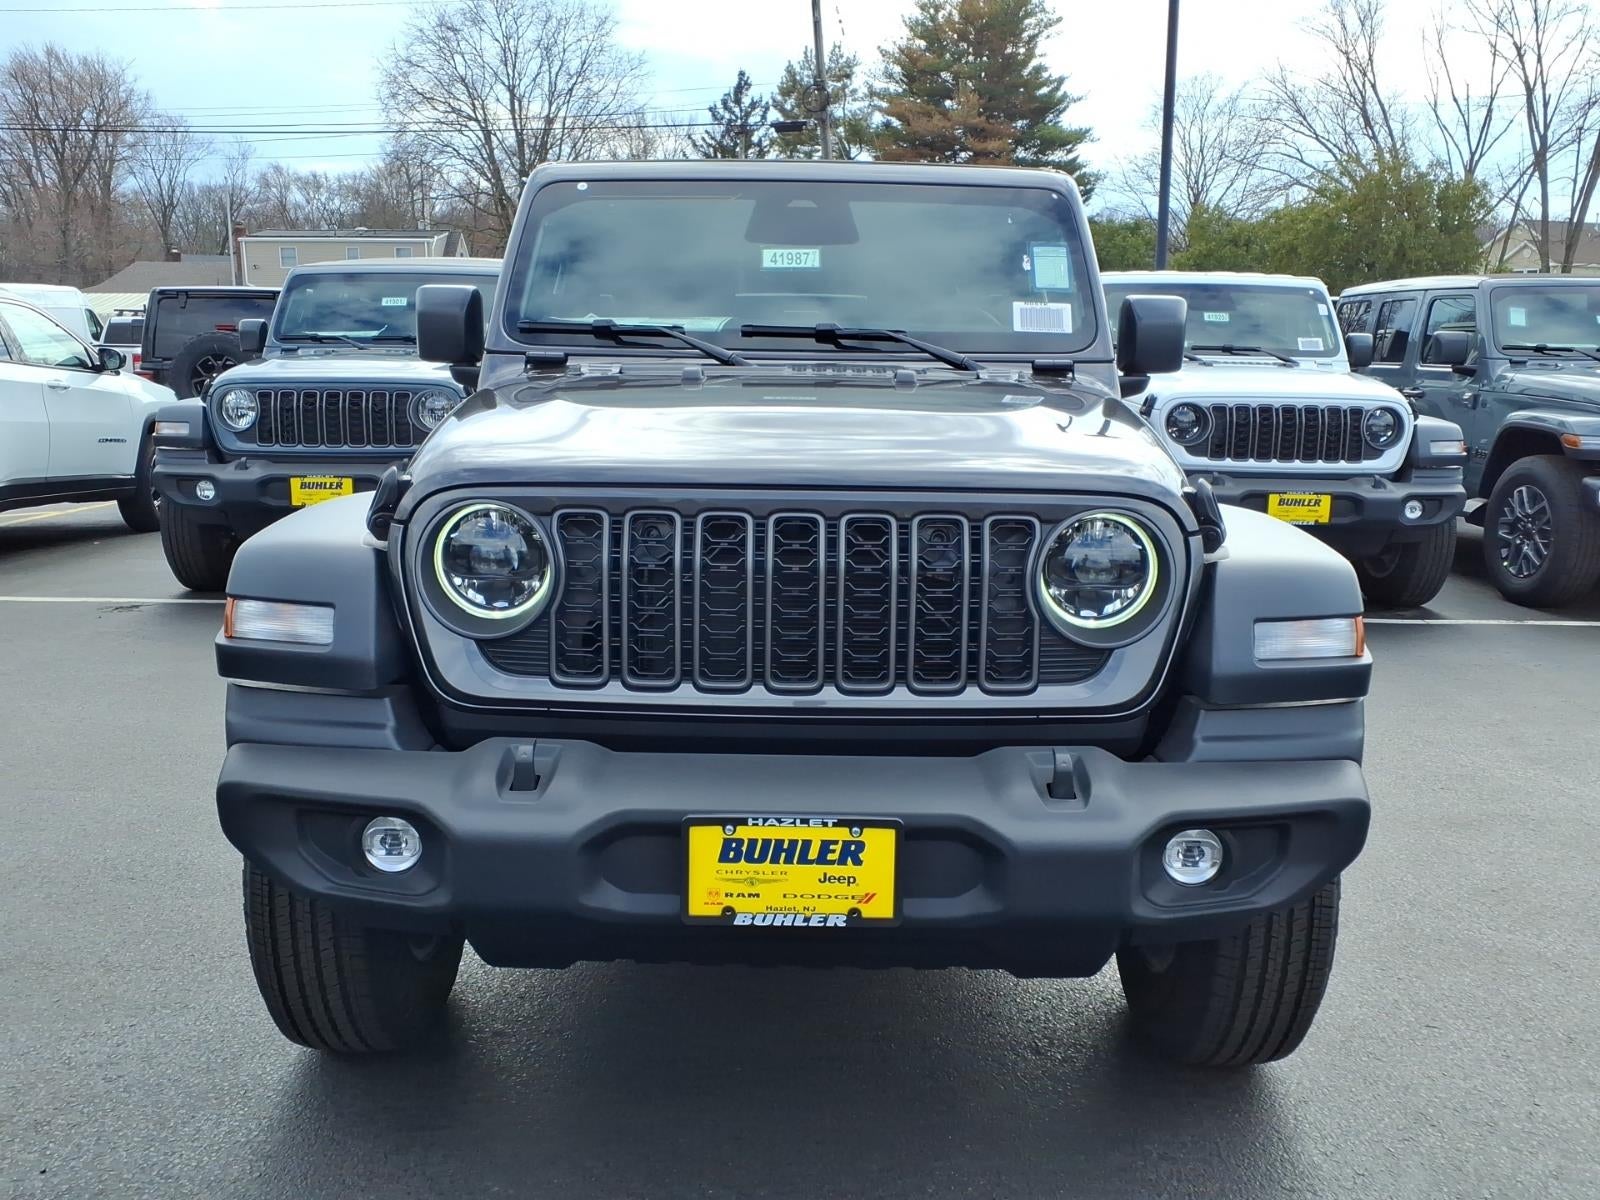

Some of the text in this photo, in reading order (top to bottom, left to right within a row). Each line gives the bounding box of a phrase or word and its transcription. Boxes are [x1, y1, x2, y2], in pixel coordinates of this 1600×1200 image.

[770, 251, 810, 265] 41987
[300, 481, 343, 490] BUHLER
[1278, 498, 1322, 507] BUHLER
[747, 817, 838, 828] HAZLET
[717, 837, 866, 867] BUHLER
[817, 872, 857, 887] Jeep
[782, 893, 864, 901] DODGE
[765, 905, 800, 914] Hazlet,
[733, 912, 848, 927] BUHLER
